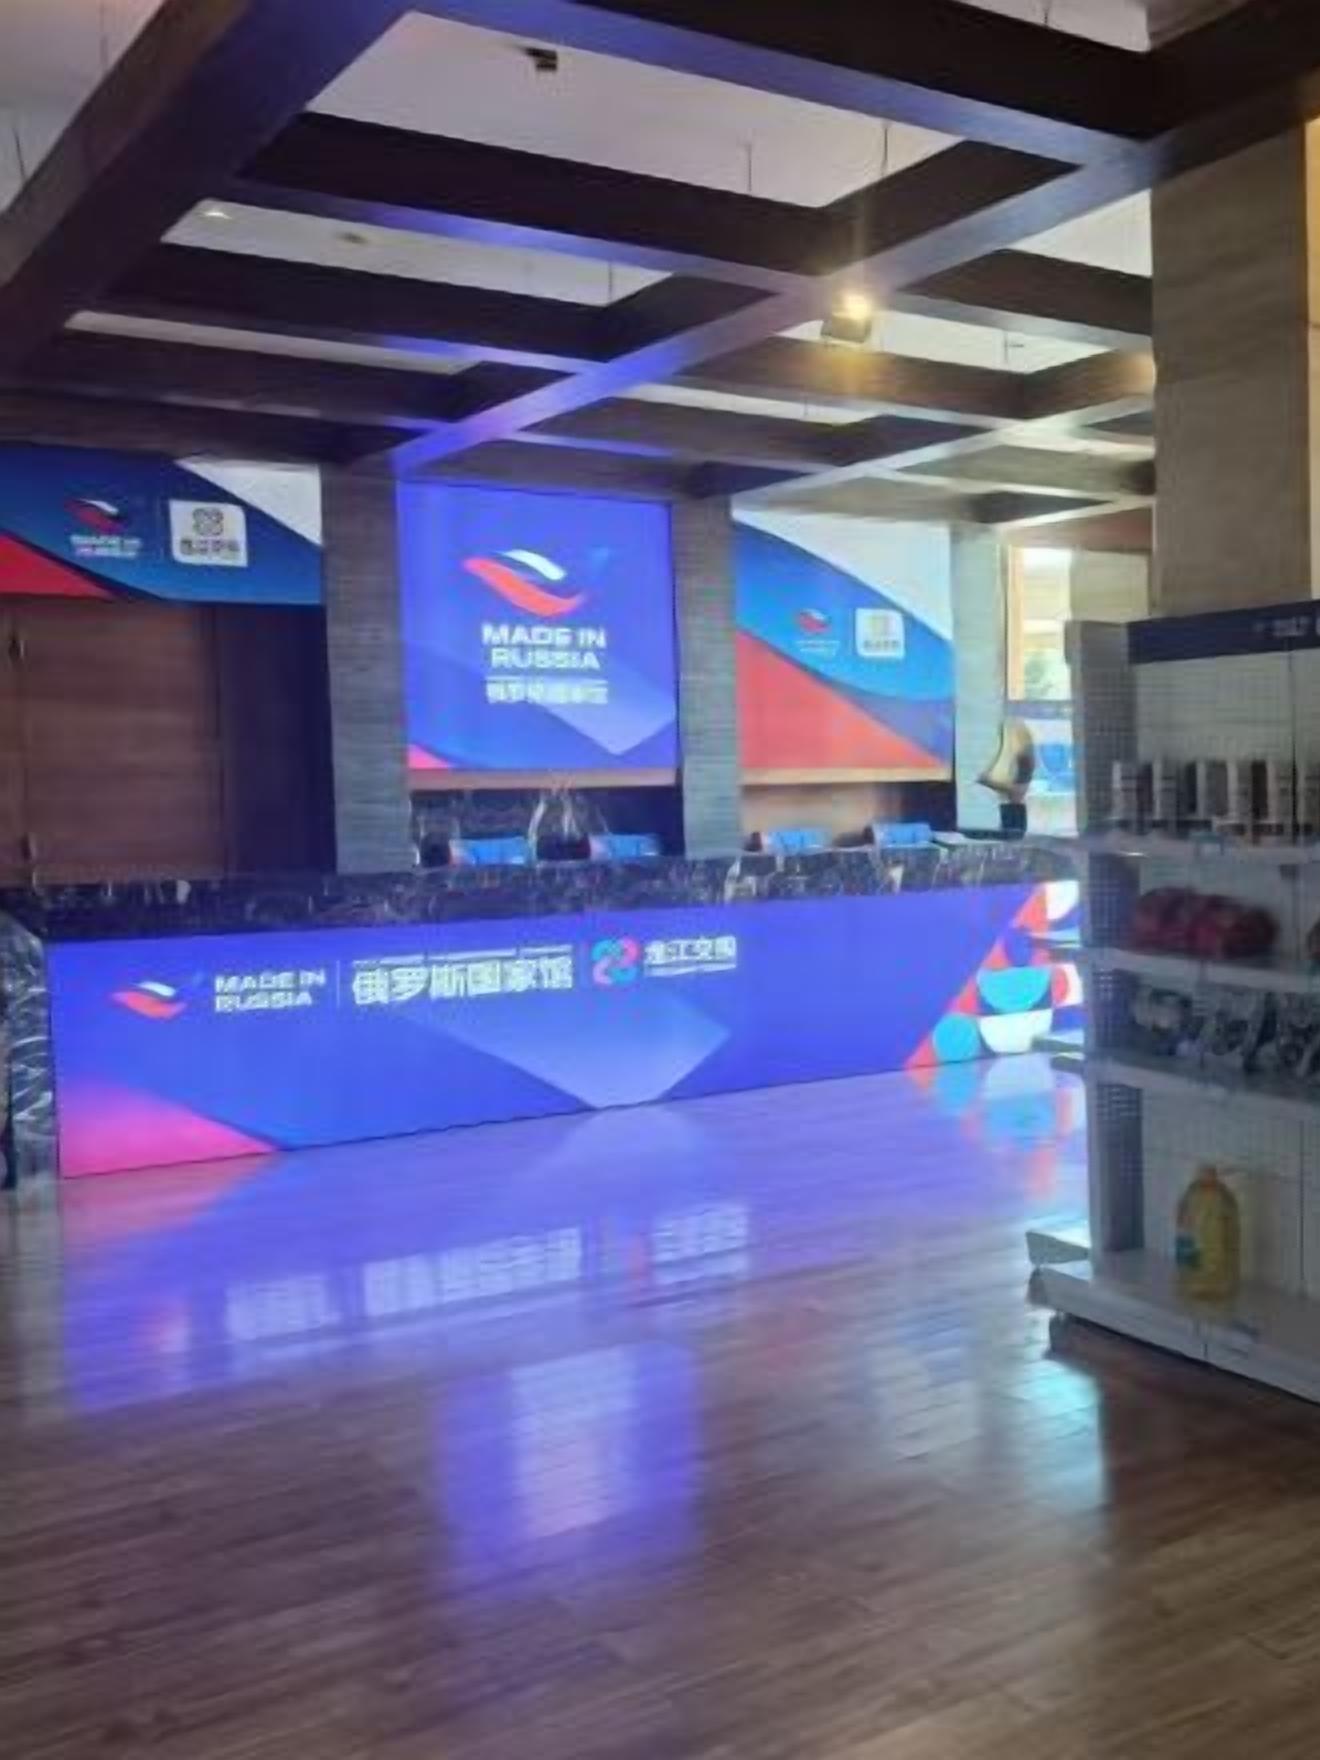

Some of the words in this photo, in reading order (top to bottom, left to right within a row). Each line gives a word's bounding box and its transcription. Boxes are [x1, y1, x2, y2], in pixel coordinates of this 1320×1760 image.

[481, 624, 571, 645] MADE
[579, 627, 606, 648] IN
[491, 647, 600, 669] RUSSIA
[352, 956, 572, 1004] 俄罗斯国家馆
